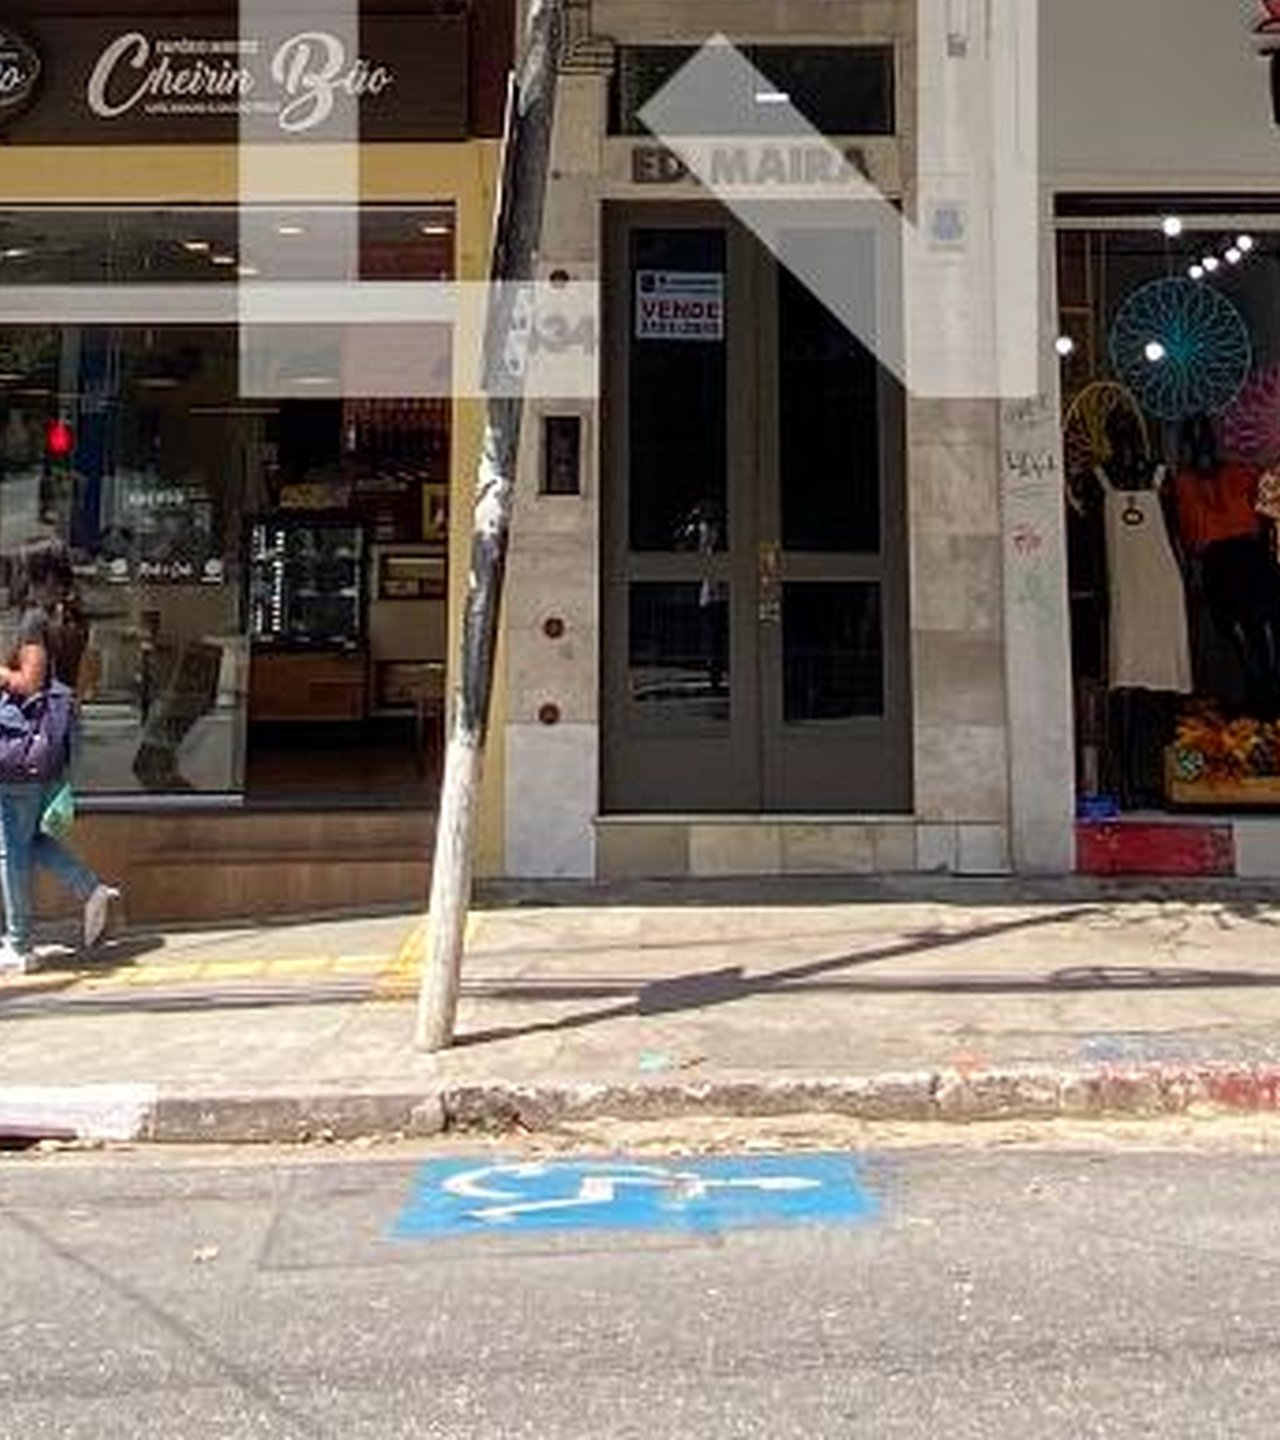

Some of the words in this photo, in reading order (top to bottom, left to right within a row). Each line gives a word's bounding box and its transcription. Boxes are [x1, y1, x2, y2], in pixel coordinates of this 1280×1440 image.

[87, 30, 257, 117] Cheirin
[270, 30, 395, 132] Bão
[710, 146, 876, 184] MAIRA
[641, 299, 719, 319] VENDE
